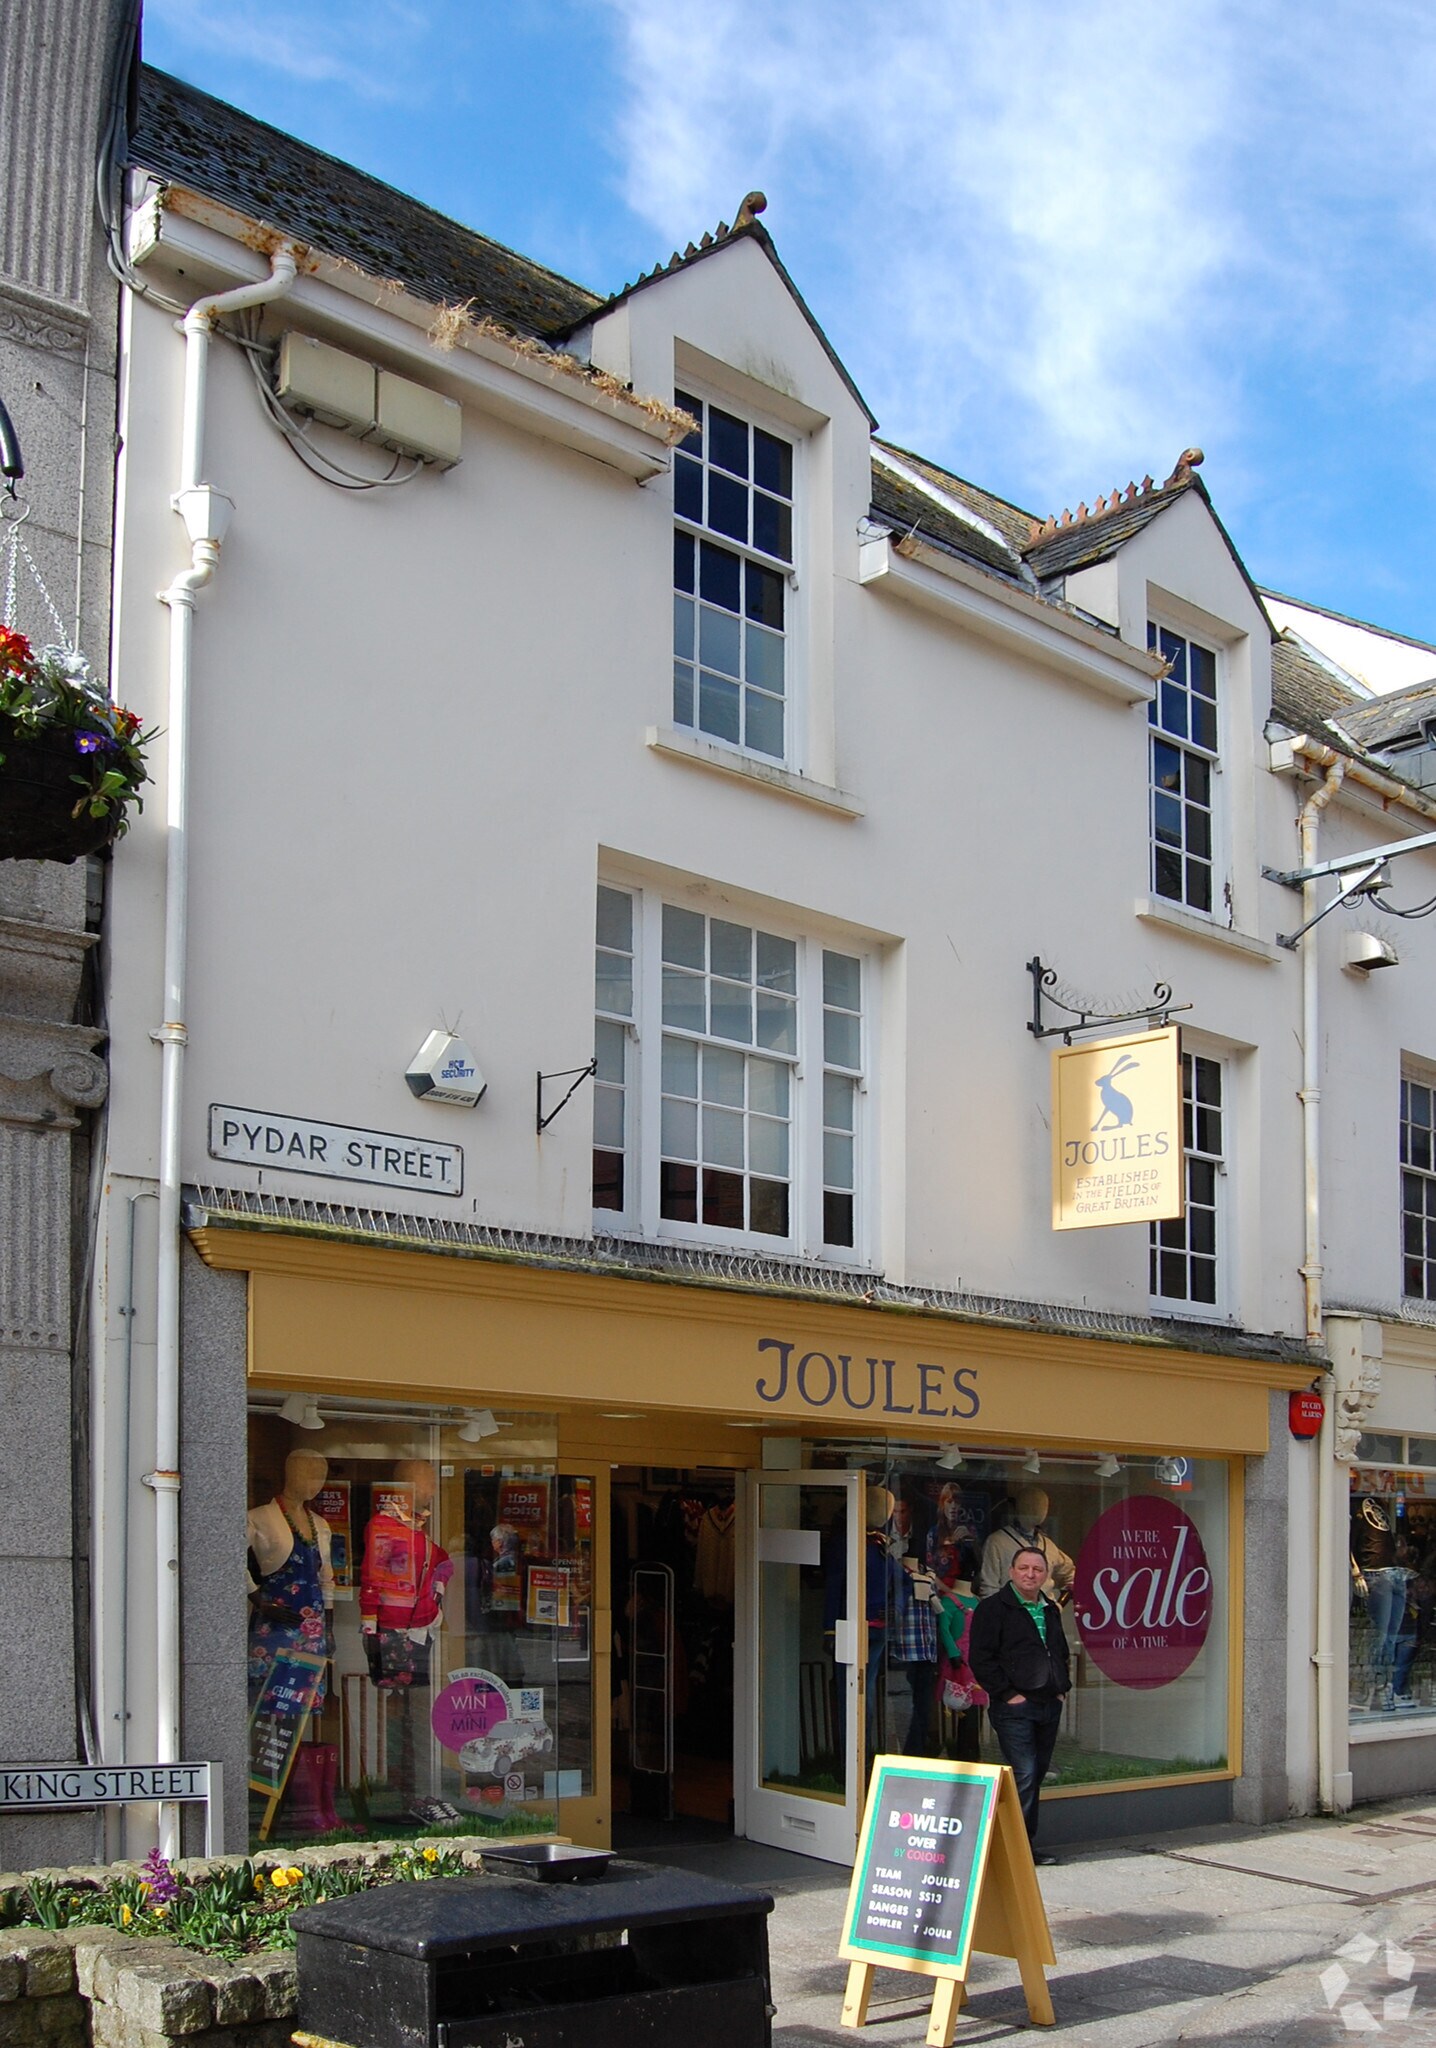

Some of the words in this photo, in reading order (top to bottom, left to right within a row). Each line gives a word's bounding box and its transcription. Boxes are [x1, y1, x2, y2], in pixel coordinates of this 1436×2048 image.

[441, 1068, 475, 1078] SECURITY
[223, 1120, 327, 1162] PYDAR
[347, 1142, 451, 1181] STREET
[1065, 1131, 1169, 1167] JOULES
[1076, 1169, 1159, 1189] ESTABLISHED
[1072, 1192, 1083, 1200] IN
[1086, 1190, 1103, 1199] THE
[1105, 1183, 1149, 1198] FIELDS
[1151, 1182, 1162, 1190] OF
[1076, 1201, 1111, 1214] GREAT
[1114, 1195, 1159, 1210] BRITAIN
[756, 1337, 980, 1419] JOULES
[1122, 1530, 1160, 1543] WE'RE
[1112, 1546, 1157, 1560] HAVING
[1157, 1546, 1168, 1560] A
[1082, 1526, 1210, 1630] sale
[1112, 1637, 1128, 1649] OF
[1131, 1637, 1138, 1648] A
[1140, 1635, 1168, 1648] TIME
[451, 1695, 486, 1710] WIN
[451, 1717, 486, 1731] MINI
[4, 1774, 81, 1800] KING
[94, 1769, 200, 1797] STREET
[922, 1798, 936, 1810] BE
[888, 1810, 962, 1835] BOWLED
[907, 1836, 937, 1850] OVER
[894, 1847, 905, 1857] BY
[906, 1849, 946, 1864] COLOUR
[875, 1867, 902, 1880] TEAM
[921, 1874, 960, 1889] JOULES
[871, 1884, 912, 1899] SEASON
[918, 1891, 942, 1904] SS13
[868, 1900, 909, 1916] RANGES
[915, 1908, 922, 1918] 3
[866, 1915, 902, 1930] BOWLER
[913, 1924, 919, 1934] T
[923, 1926, 952, 1940] JOULE
